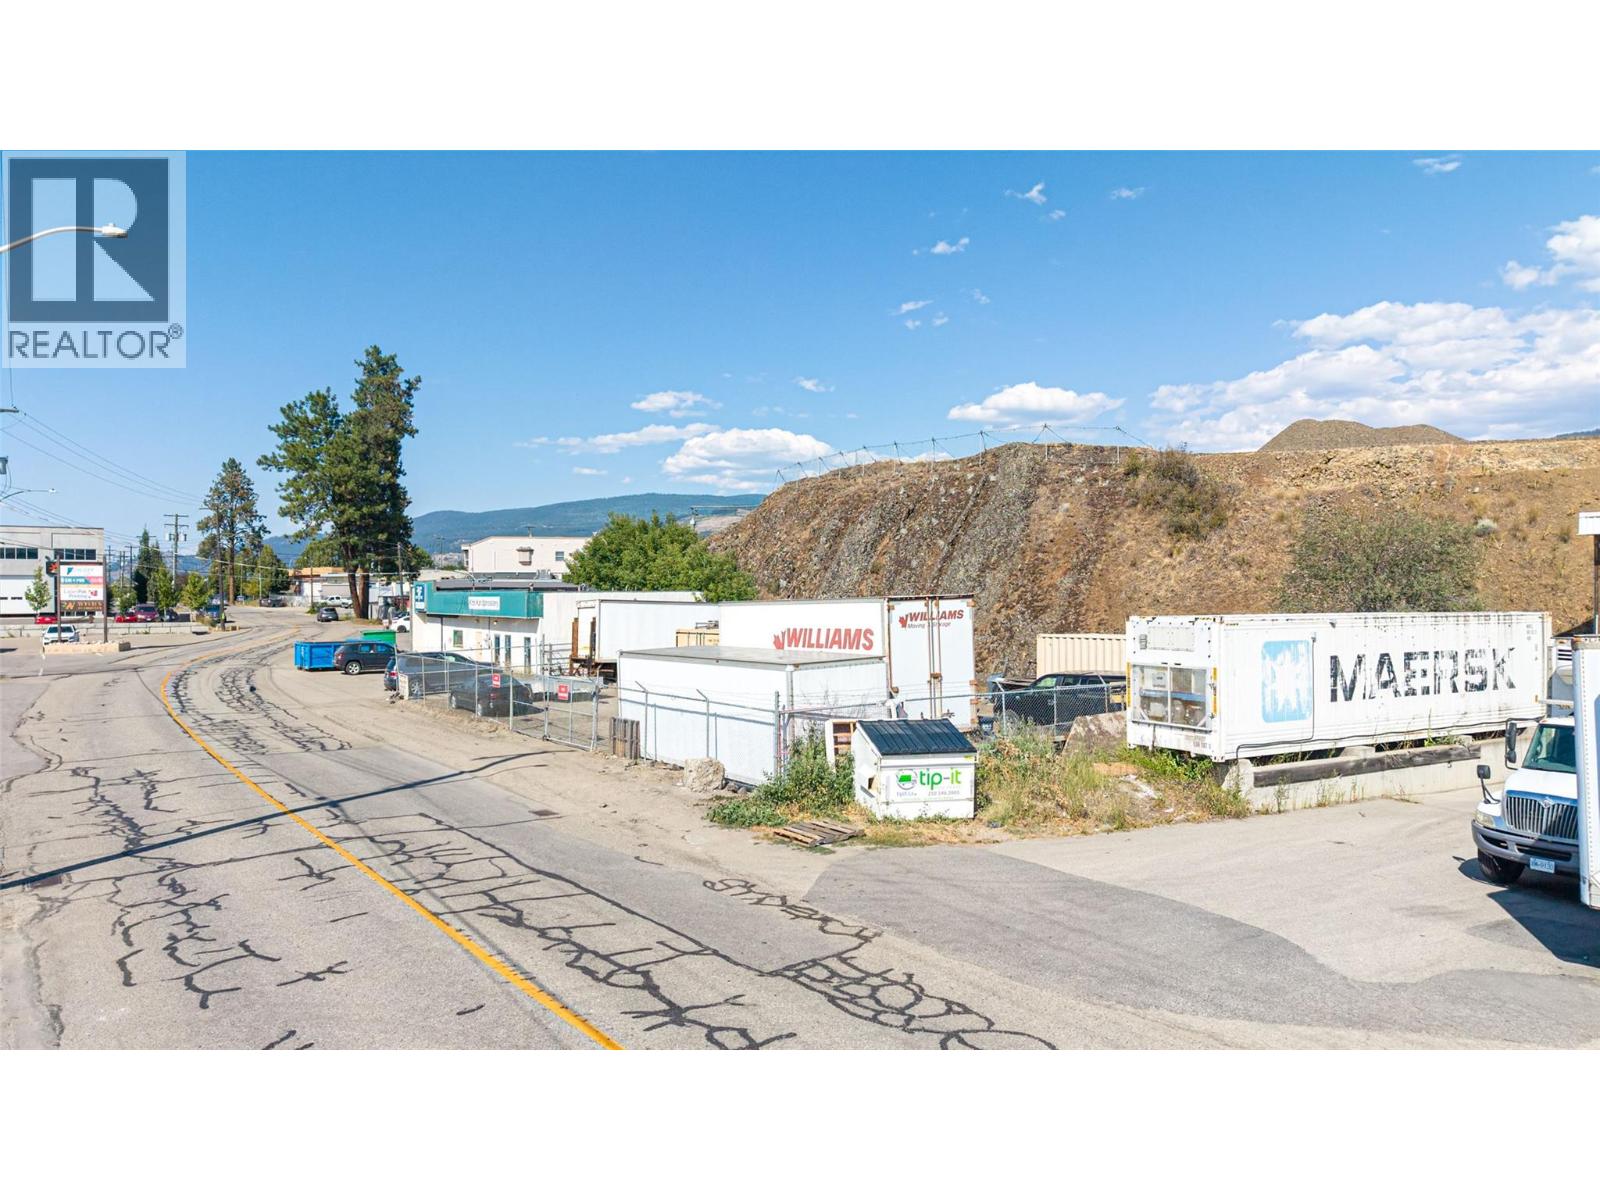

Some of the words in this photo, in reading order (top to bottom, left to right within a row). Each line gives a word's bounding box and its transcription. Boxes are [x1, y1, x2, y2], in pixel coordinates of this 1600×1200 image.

[786, 627, 874, 651] WILLIAMS
[1329, 647, 1516, 703] MAERSK
[919, 766, 962, 791] tip-it
